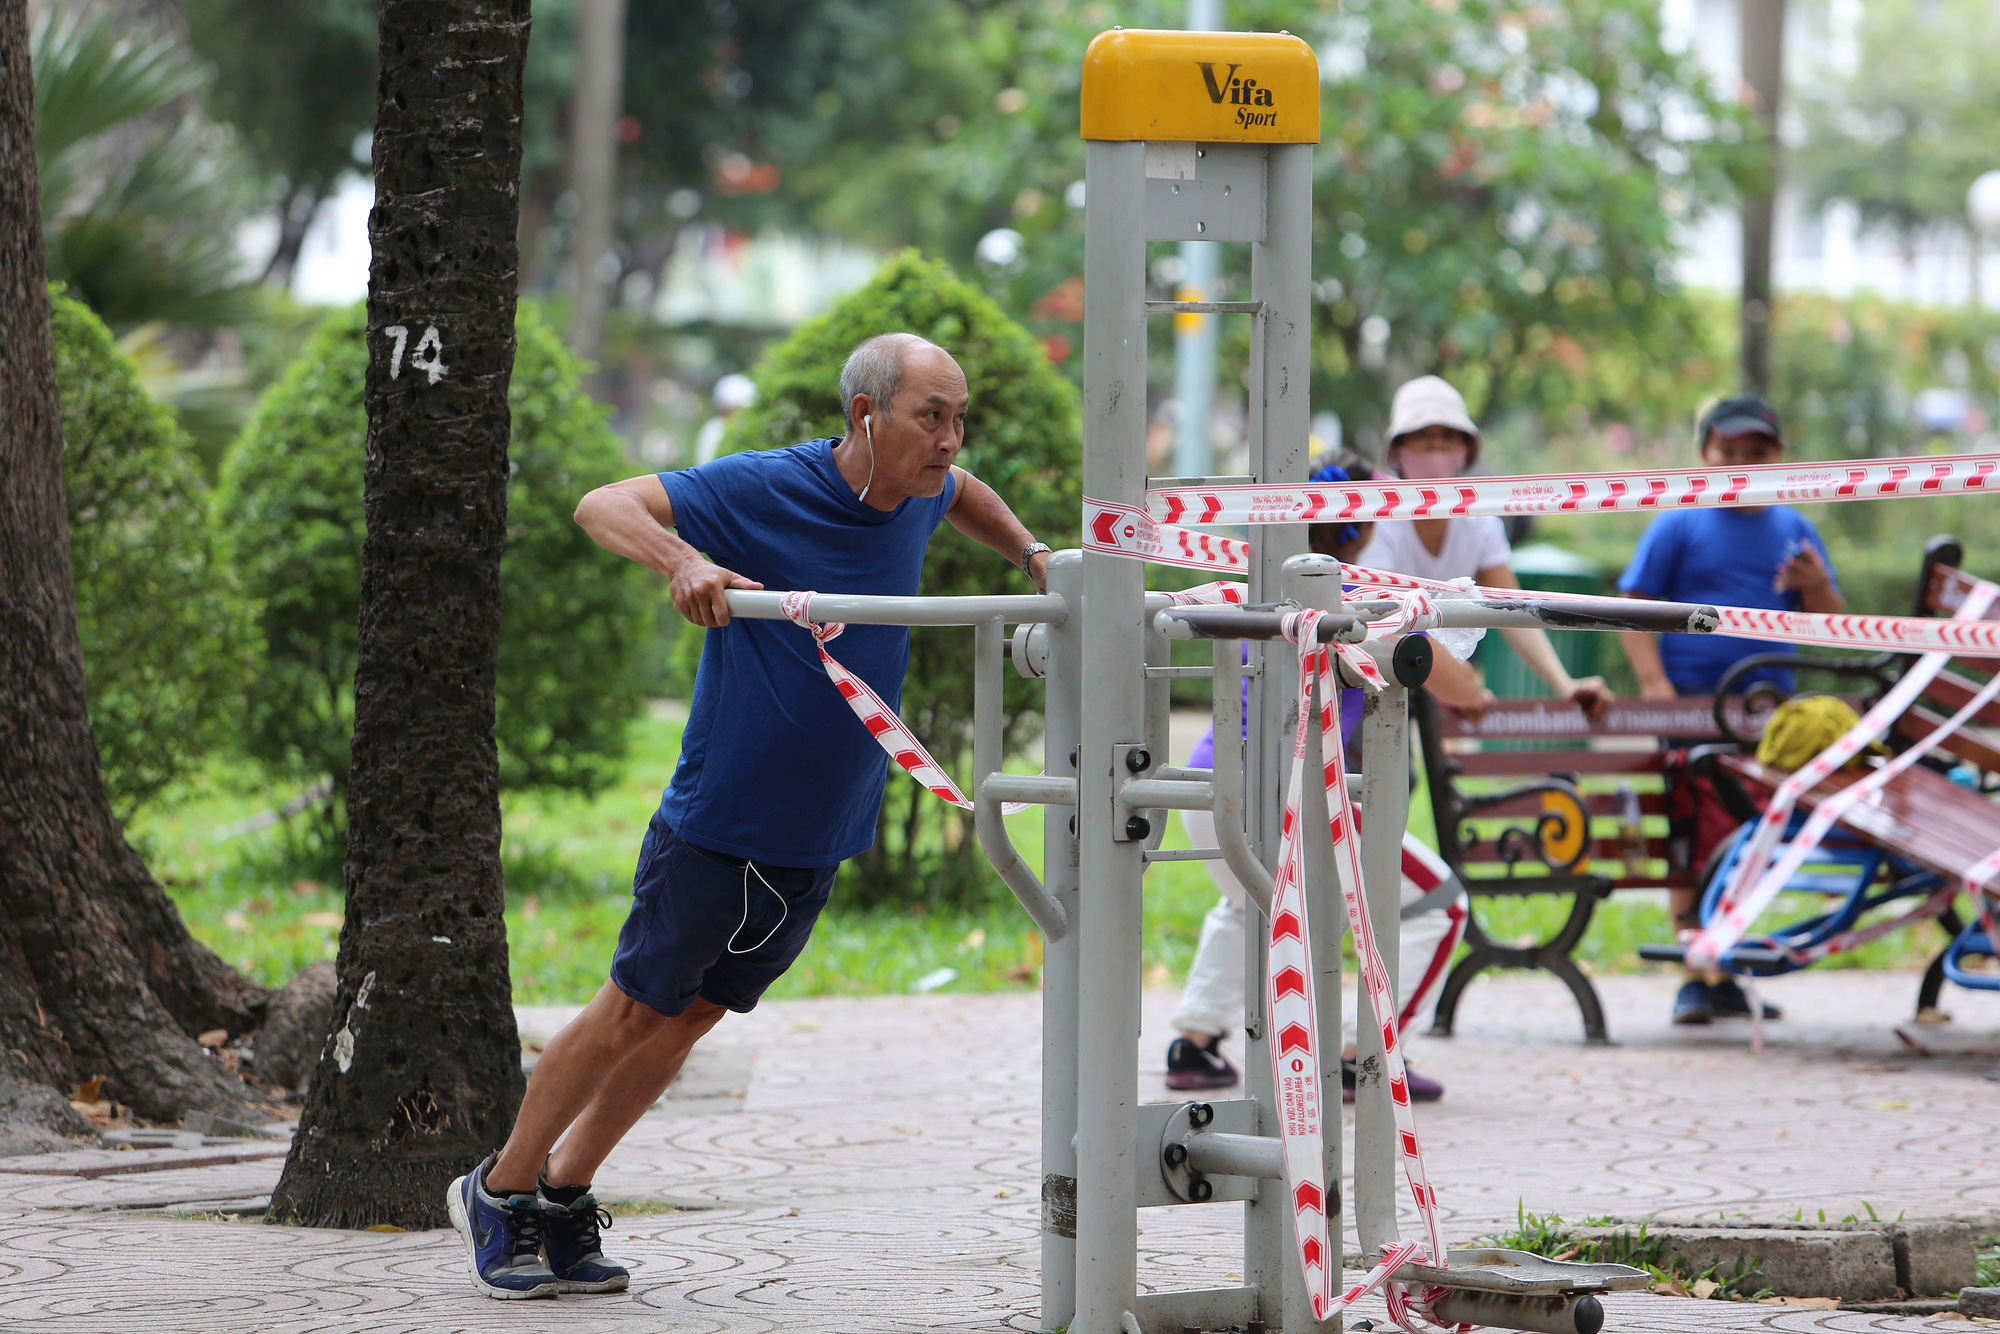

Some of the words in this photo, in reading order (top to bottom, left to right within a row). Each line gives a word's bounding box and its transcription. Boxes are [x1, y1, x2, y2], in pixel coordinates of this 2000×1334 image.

[1195, 61, 1275, 107] Vifa
[1234, 106, 1278, 129] Sport
[385, 324, 449, 386] 74
[1294, 1076, 1303, 1093] AREA
[1295, 1093, 1305, 1123] ALLOWED
[1297, 1123, 1306, 1136] NOT
